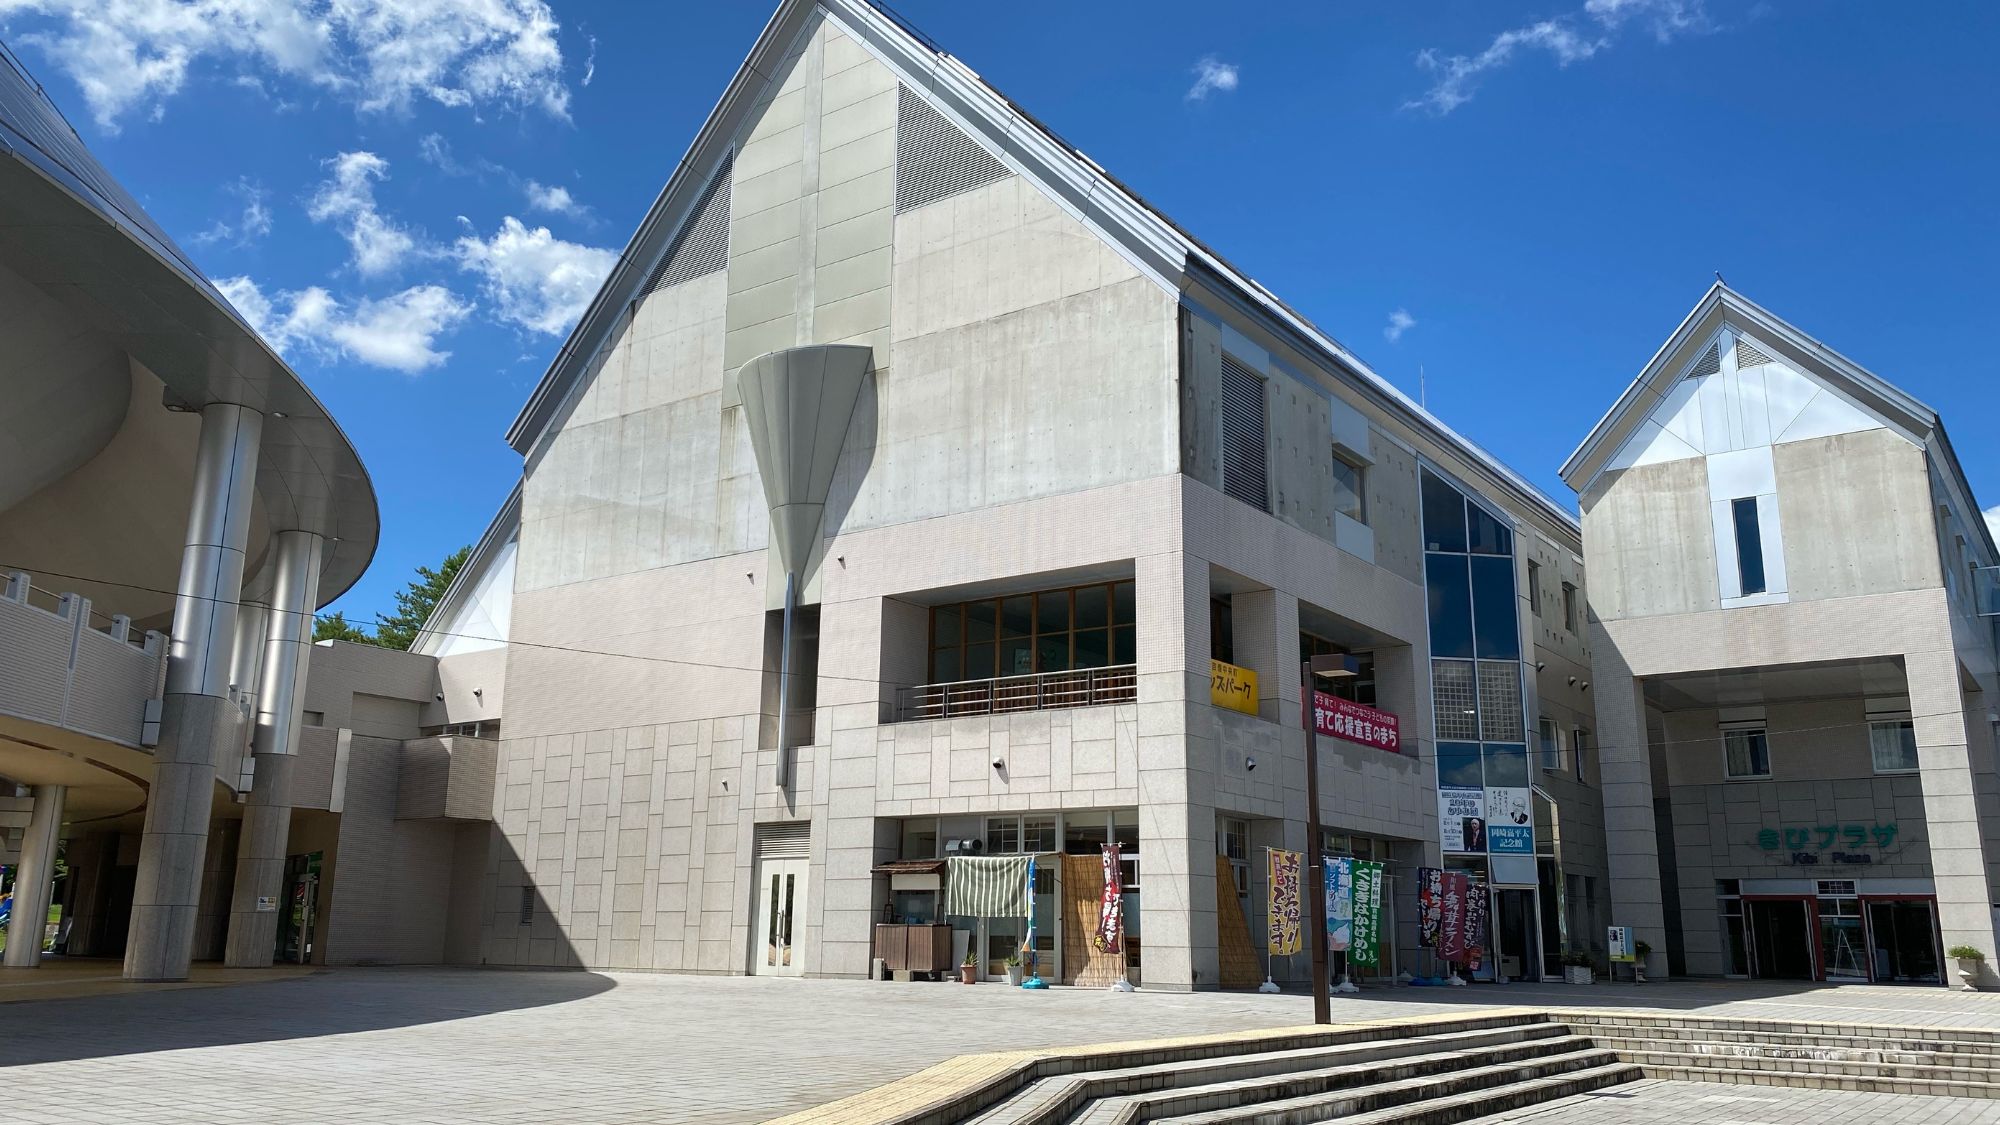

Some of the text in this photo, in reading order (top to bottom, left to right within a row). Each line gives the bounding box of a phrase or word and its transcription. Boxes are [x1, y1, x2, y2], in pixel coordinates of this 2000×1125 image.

[1758, 823, 1897, 850] きびプラザ
